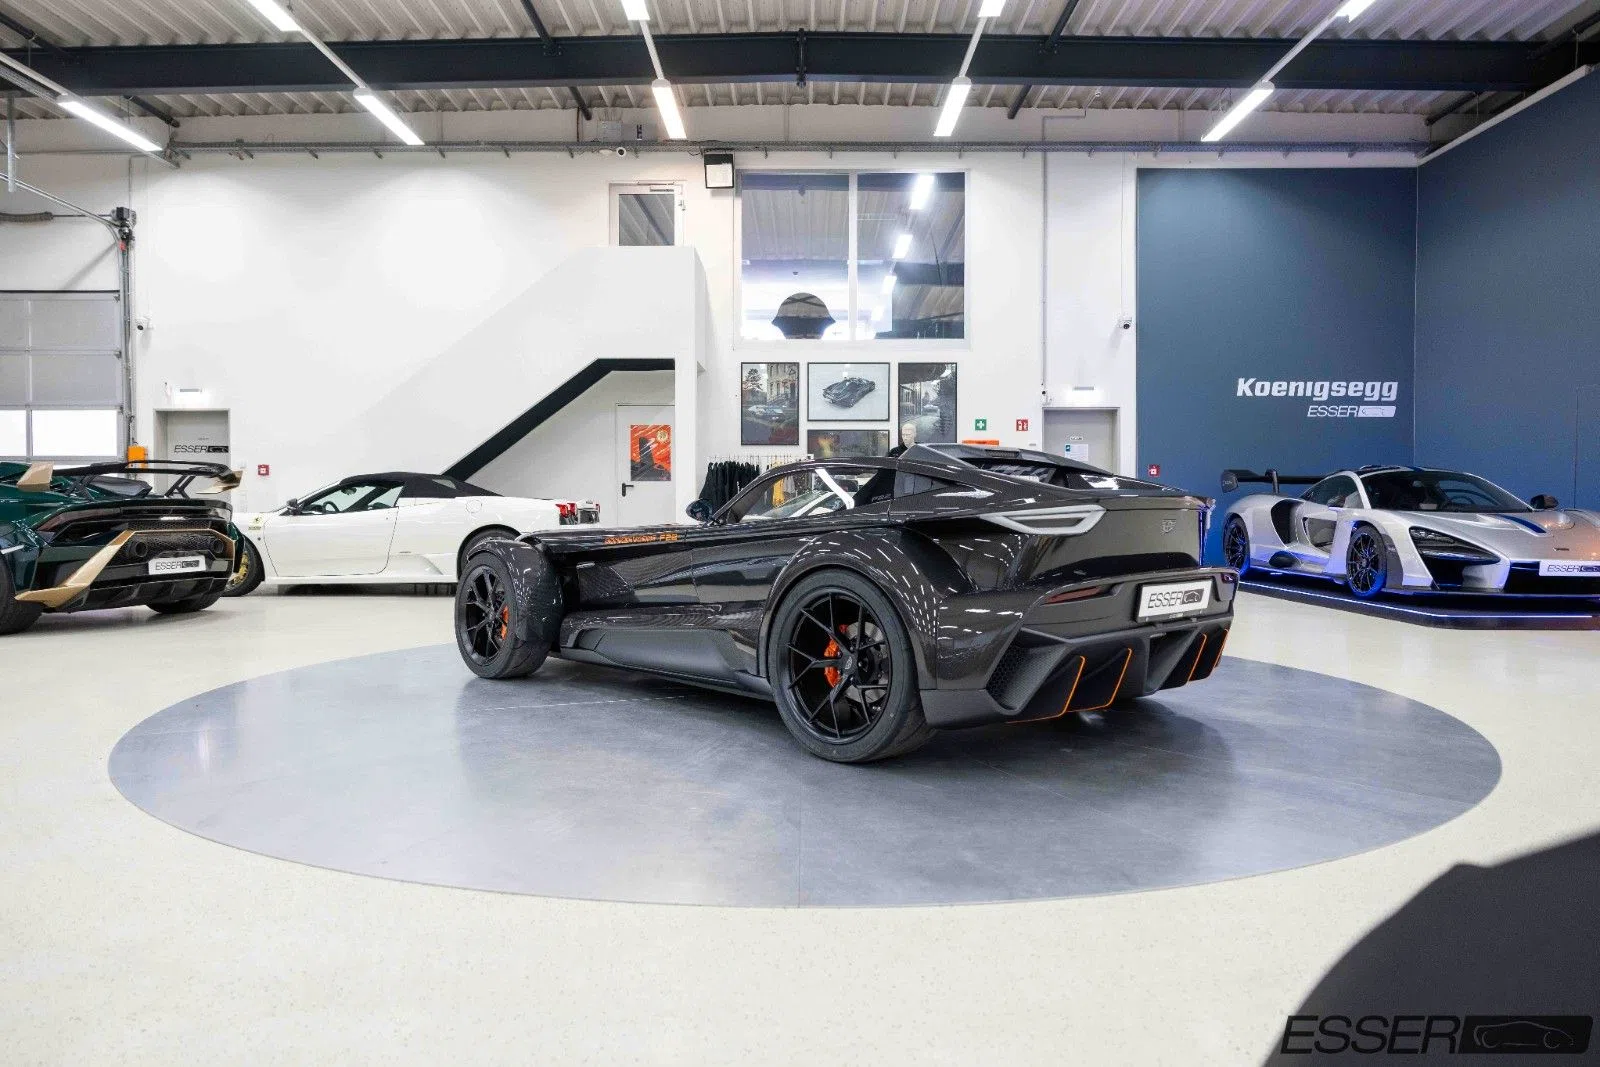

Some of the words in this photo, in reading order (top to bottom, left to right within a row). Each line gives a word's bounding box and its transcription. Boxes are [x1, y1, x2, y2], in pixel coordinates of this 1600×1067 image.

[1236, 377, 1399, 401] Koenigsegg
[1307, 405, 1358, 417] ESSER
[174, 444, 207, 453] ESSER
[155, 560, 182, 570] ESSER
[1547, 564, 1580, 572] ESSER
[1147, 590, 1184, 609] ESSER
